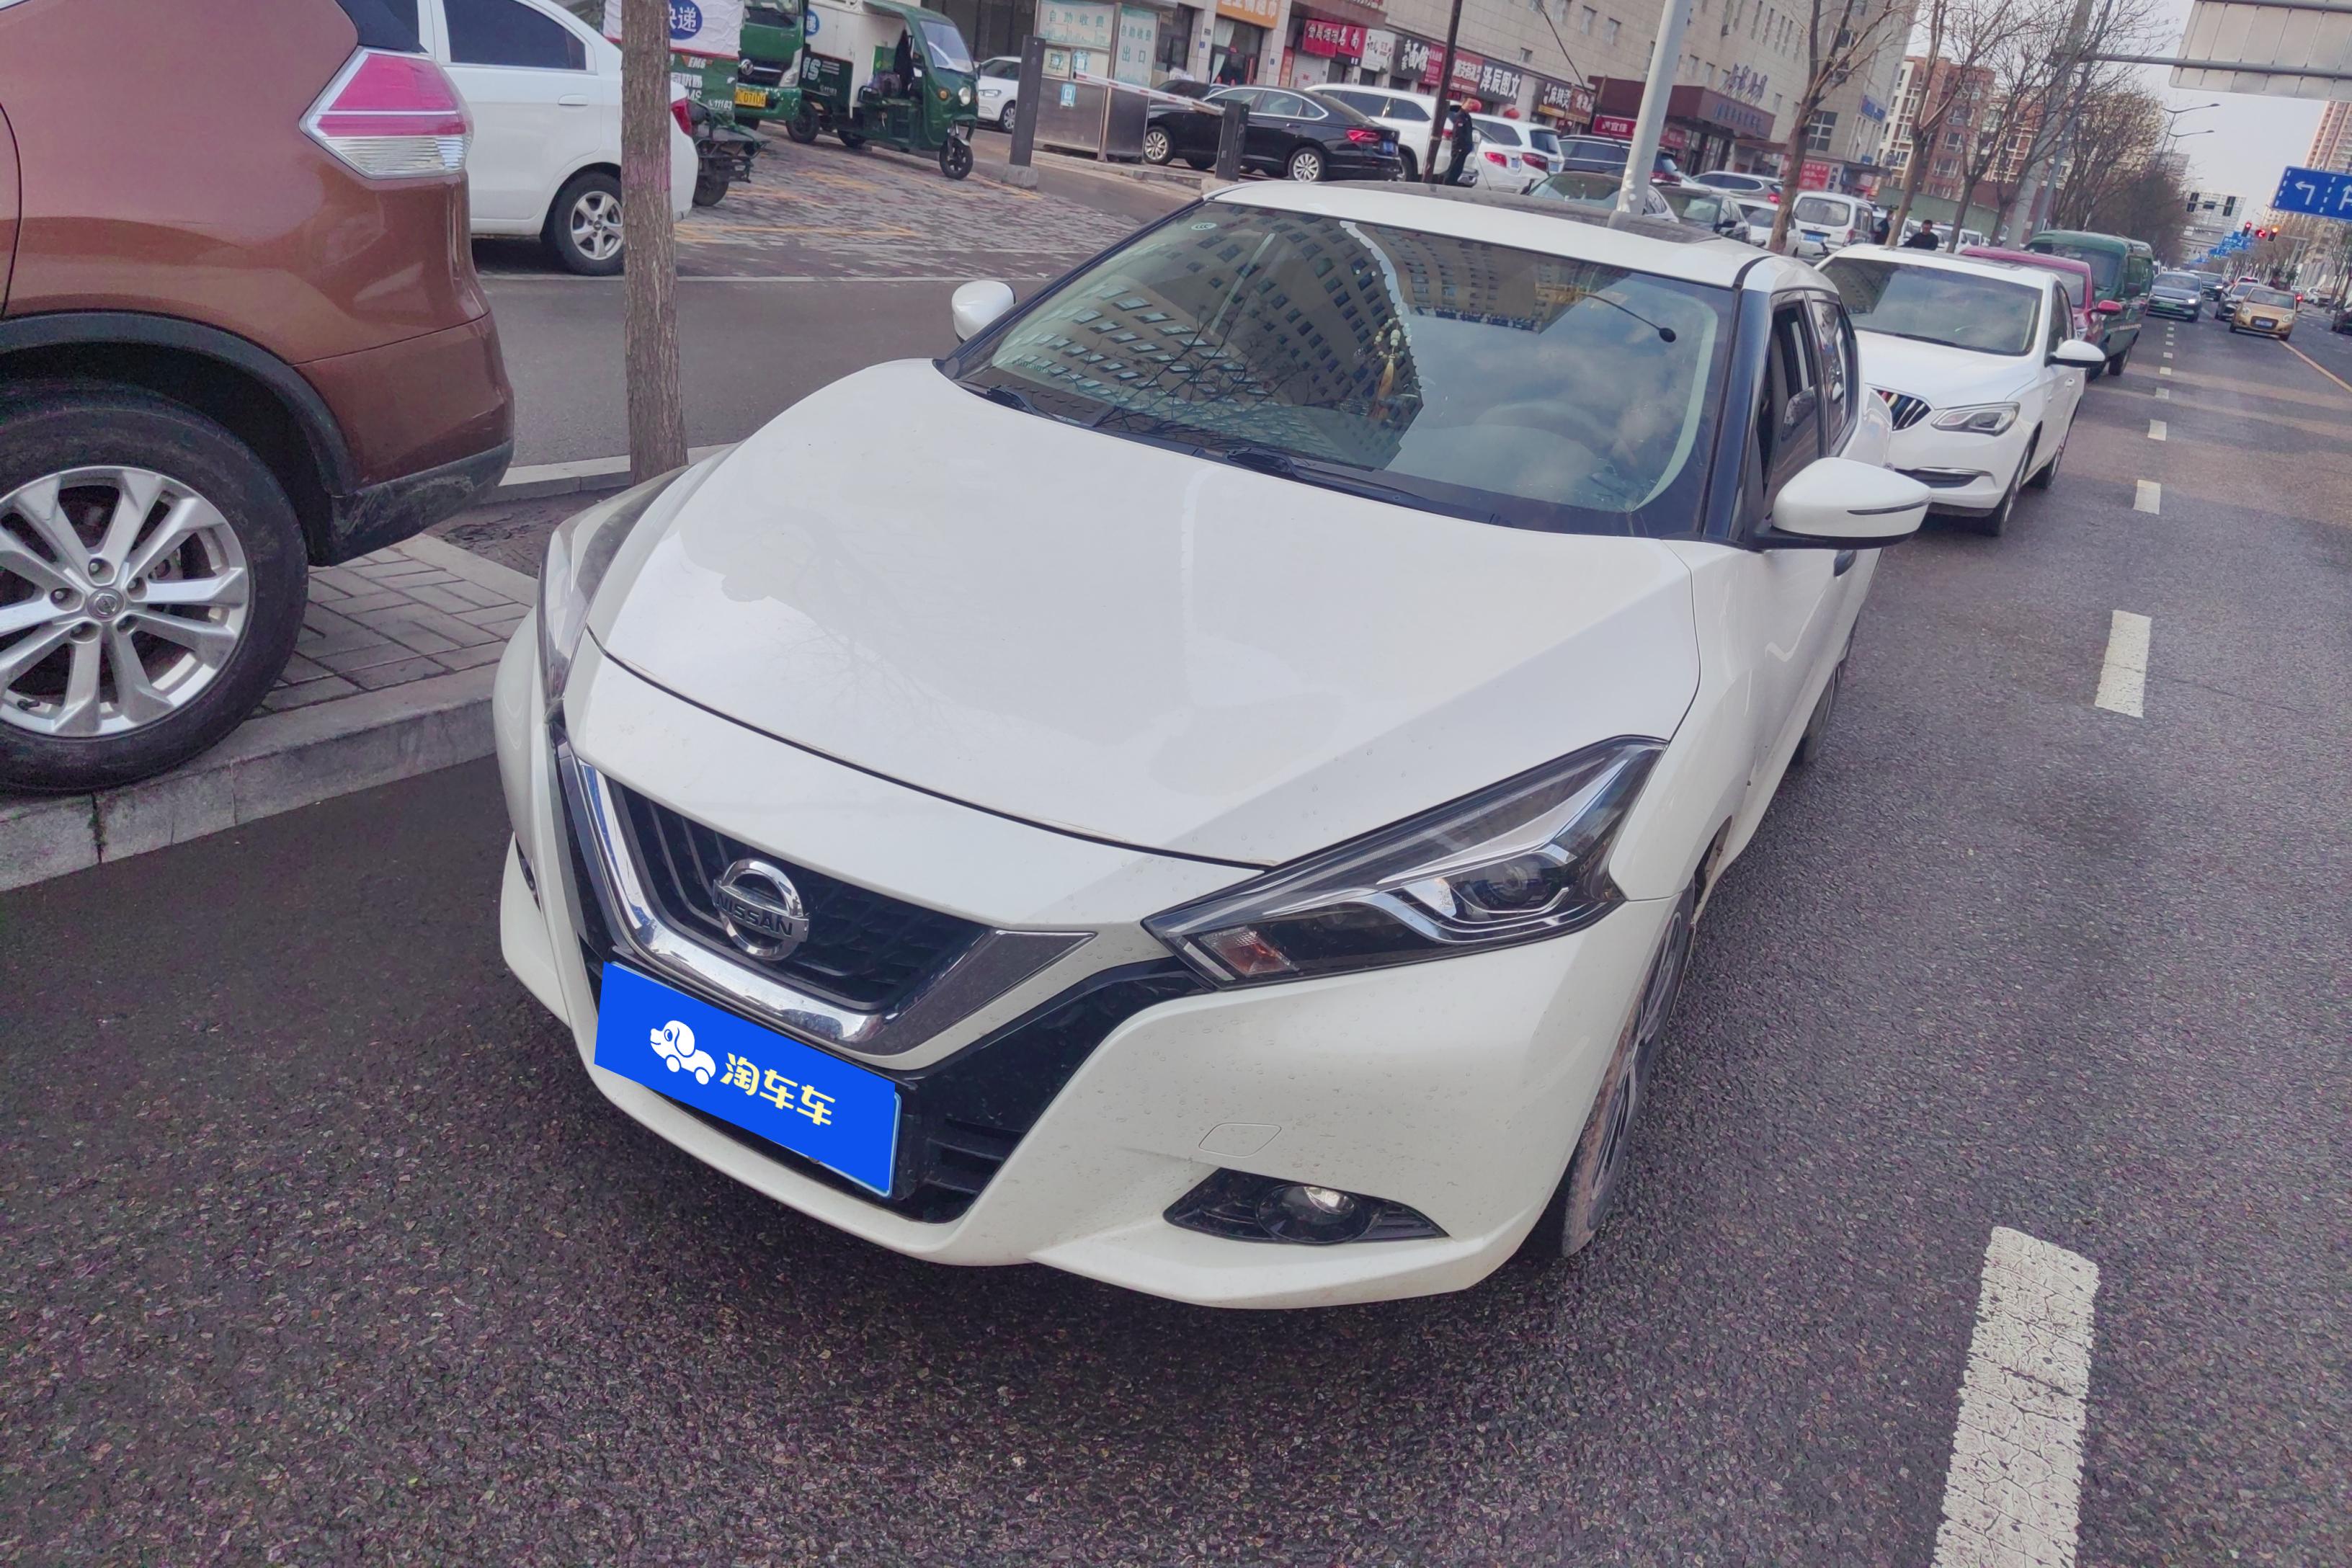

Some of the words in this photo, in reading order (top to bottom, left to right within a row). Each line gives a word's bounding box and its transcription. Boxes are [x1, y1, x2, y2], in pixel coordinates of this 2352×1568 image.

[1049, 10, 1104, 27] 自助收费
[1121, 24, 1152, 41] 自助收费
[687, 57, 706, 69] EMS
[1122, 45, 1146, 64] 出口
[1479, 65, 1520, 99] 泽辰图文
[716, 891, 793, 938] NISSAN
